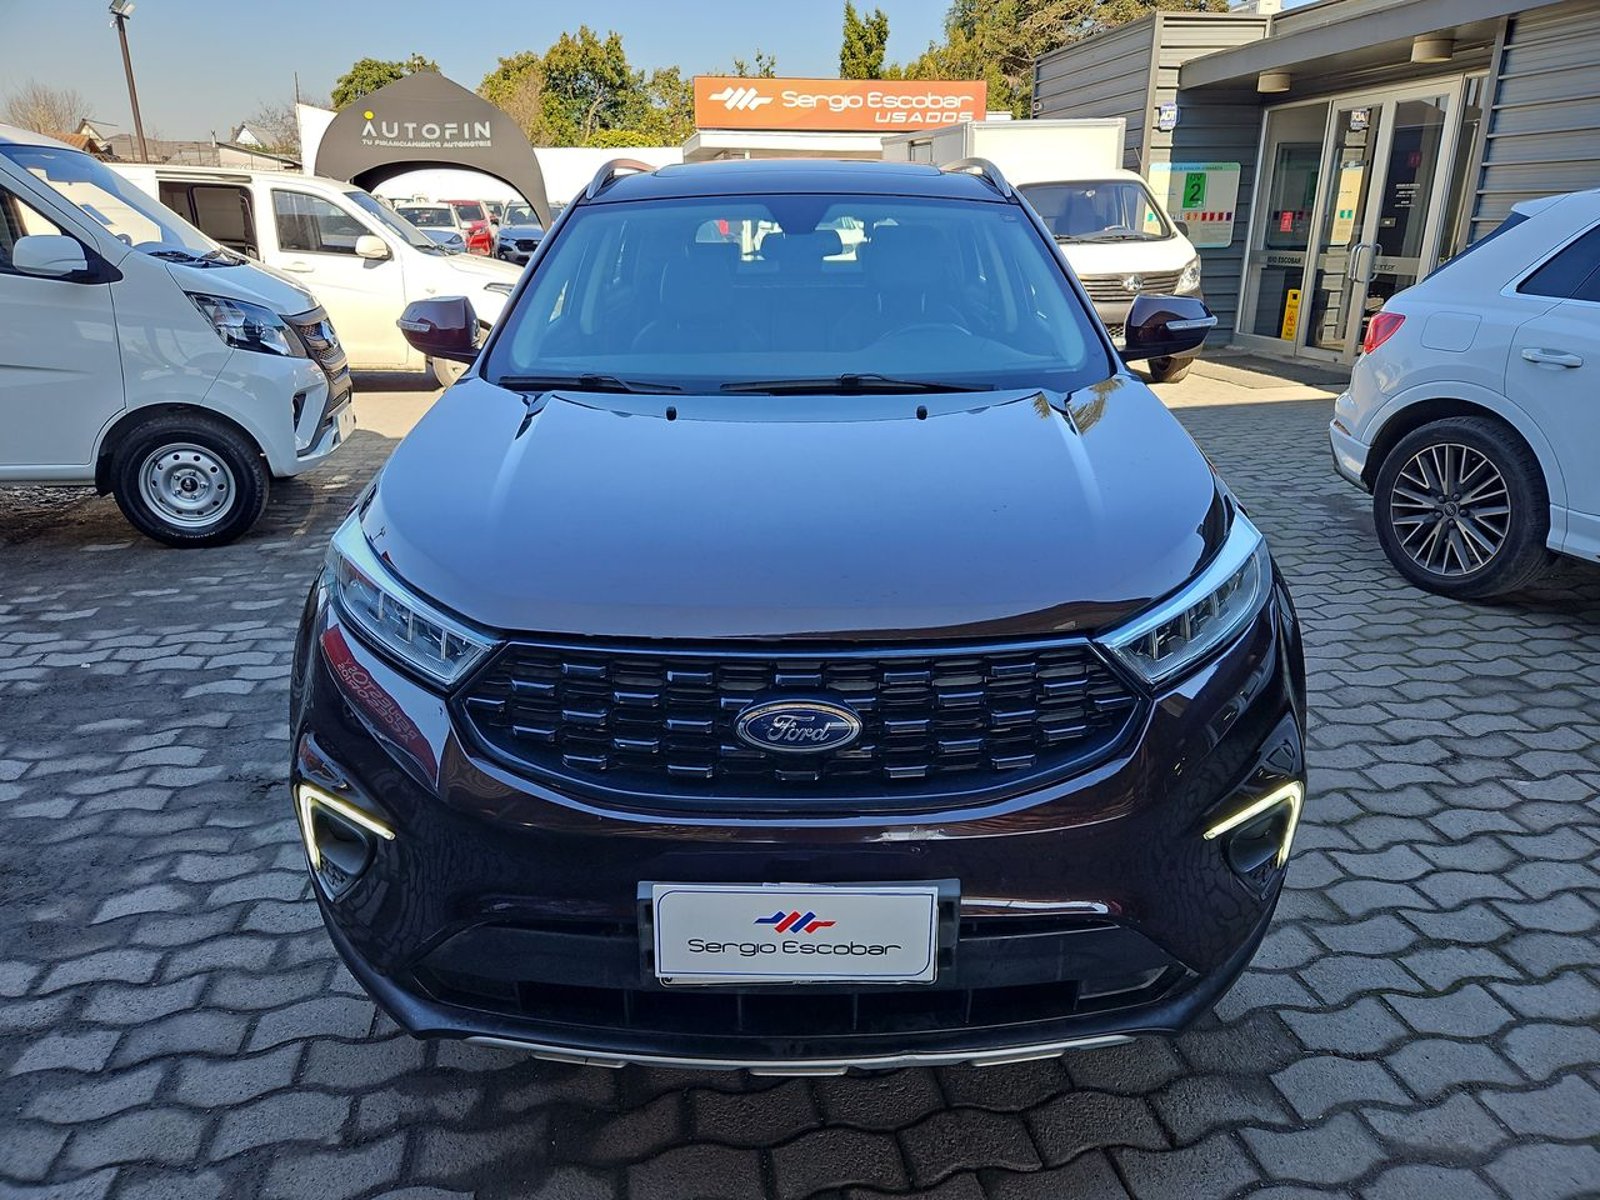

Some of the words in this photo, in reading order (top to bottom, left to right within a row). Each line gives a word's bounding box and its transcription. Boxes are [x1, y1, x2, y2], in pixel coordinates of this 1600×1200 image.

[781, 90, 862, 112] Sergio
[866, 91, 974, 109] Escobar
[874, 111, 974, 123] USADOS
[360, 120, 491, 139] AUTOFIN
[1188, 183, 1202, 202] 2
[767, 715, 831, 741] Ford
[687, 938, 776, 957] Sergio
[782, 940, 902, 956] Escobar
